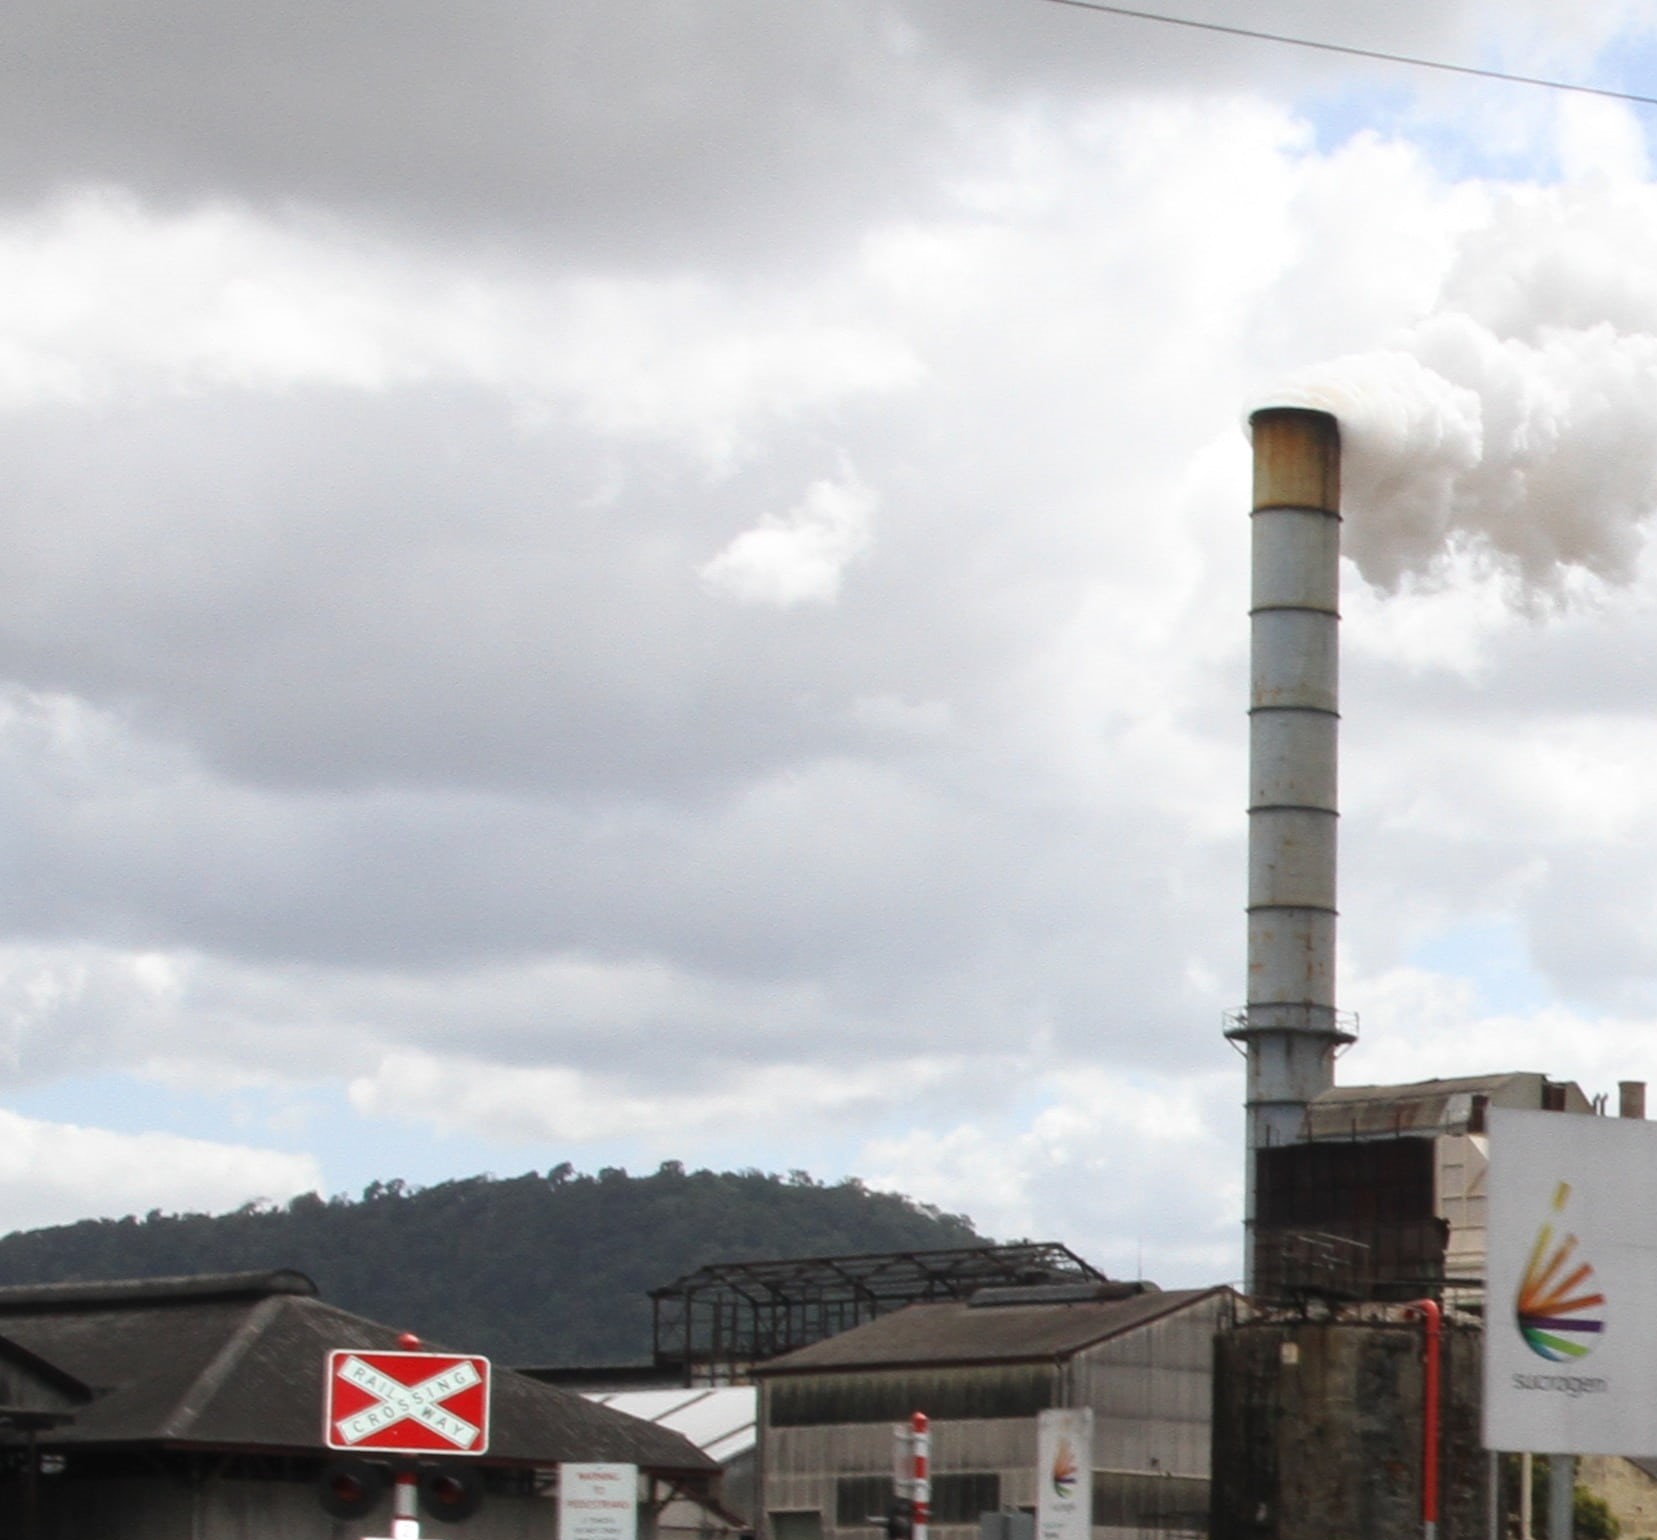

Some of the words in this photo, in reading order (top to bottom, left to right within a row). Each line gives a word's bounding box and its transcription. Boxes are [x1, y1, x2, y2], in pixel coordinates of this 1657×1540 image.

[352, 1371, 466, 1433] CROSSING
[353, 1367, 465, 1437] RAILWAY
[1511, 1373, 1608, 1398] sucrogen
